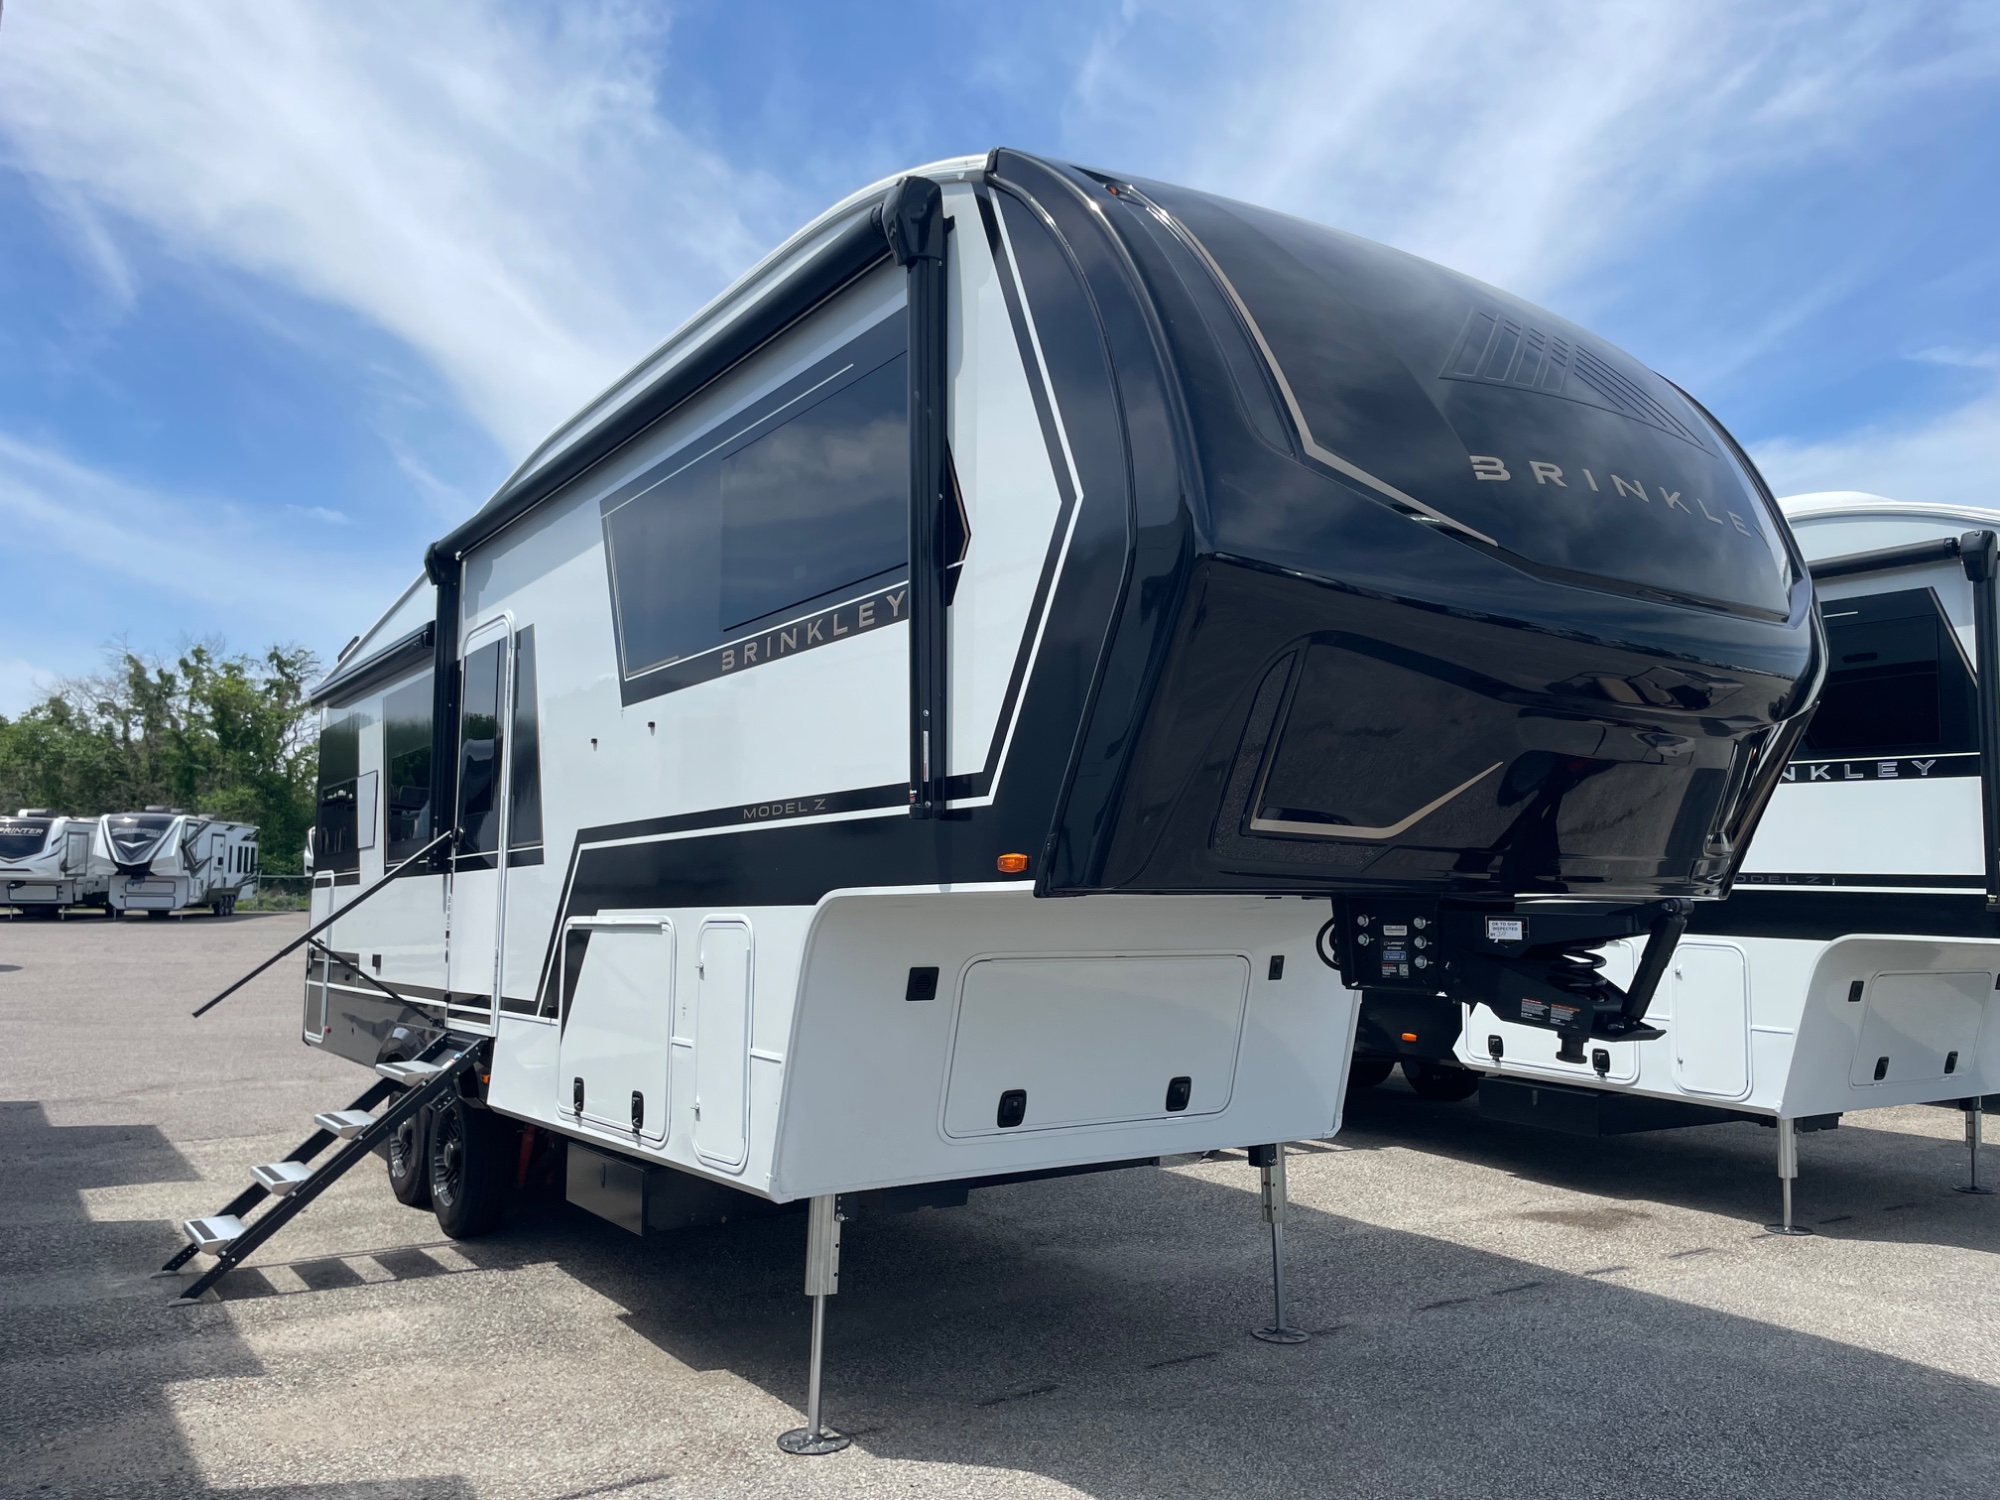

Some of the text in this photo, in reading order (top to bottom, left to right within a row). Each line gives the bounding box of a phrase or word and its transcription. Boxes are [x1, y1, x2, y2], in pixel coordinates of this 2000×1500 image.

[721, 589, 906, 672] BRINKLEY
[743, 798, 826, 820] MODEL Z
